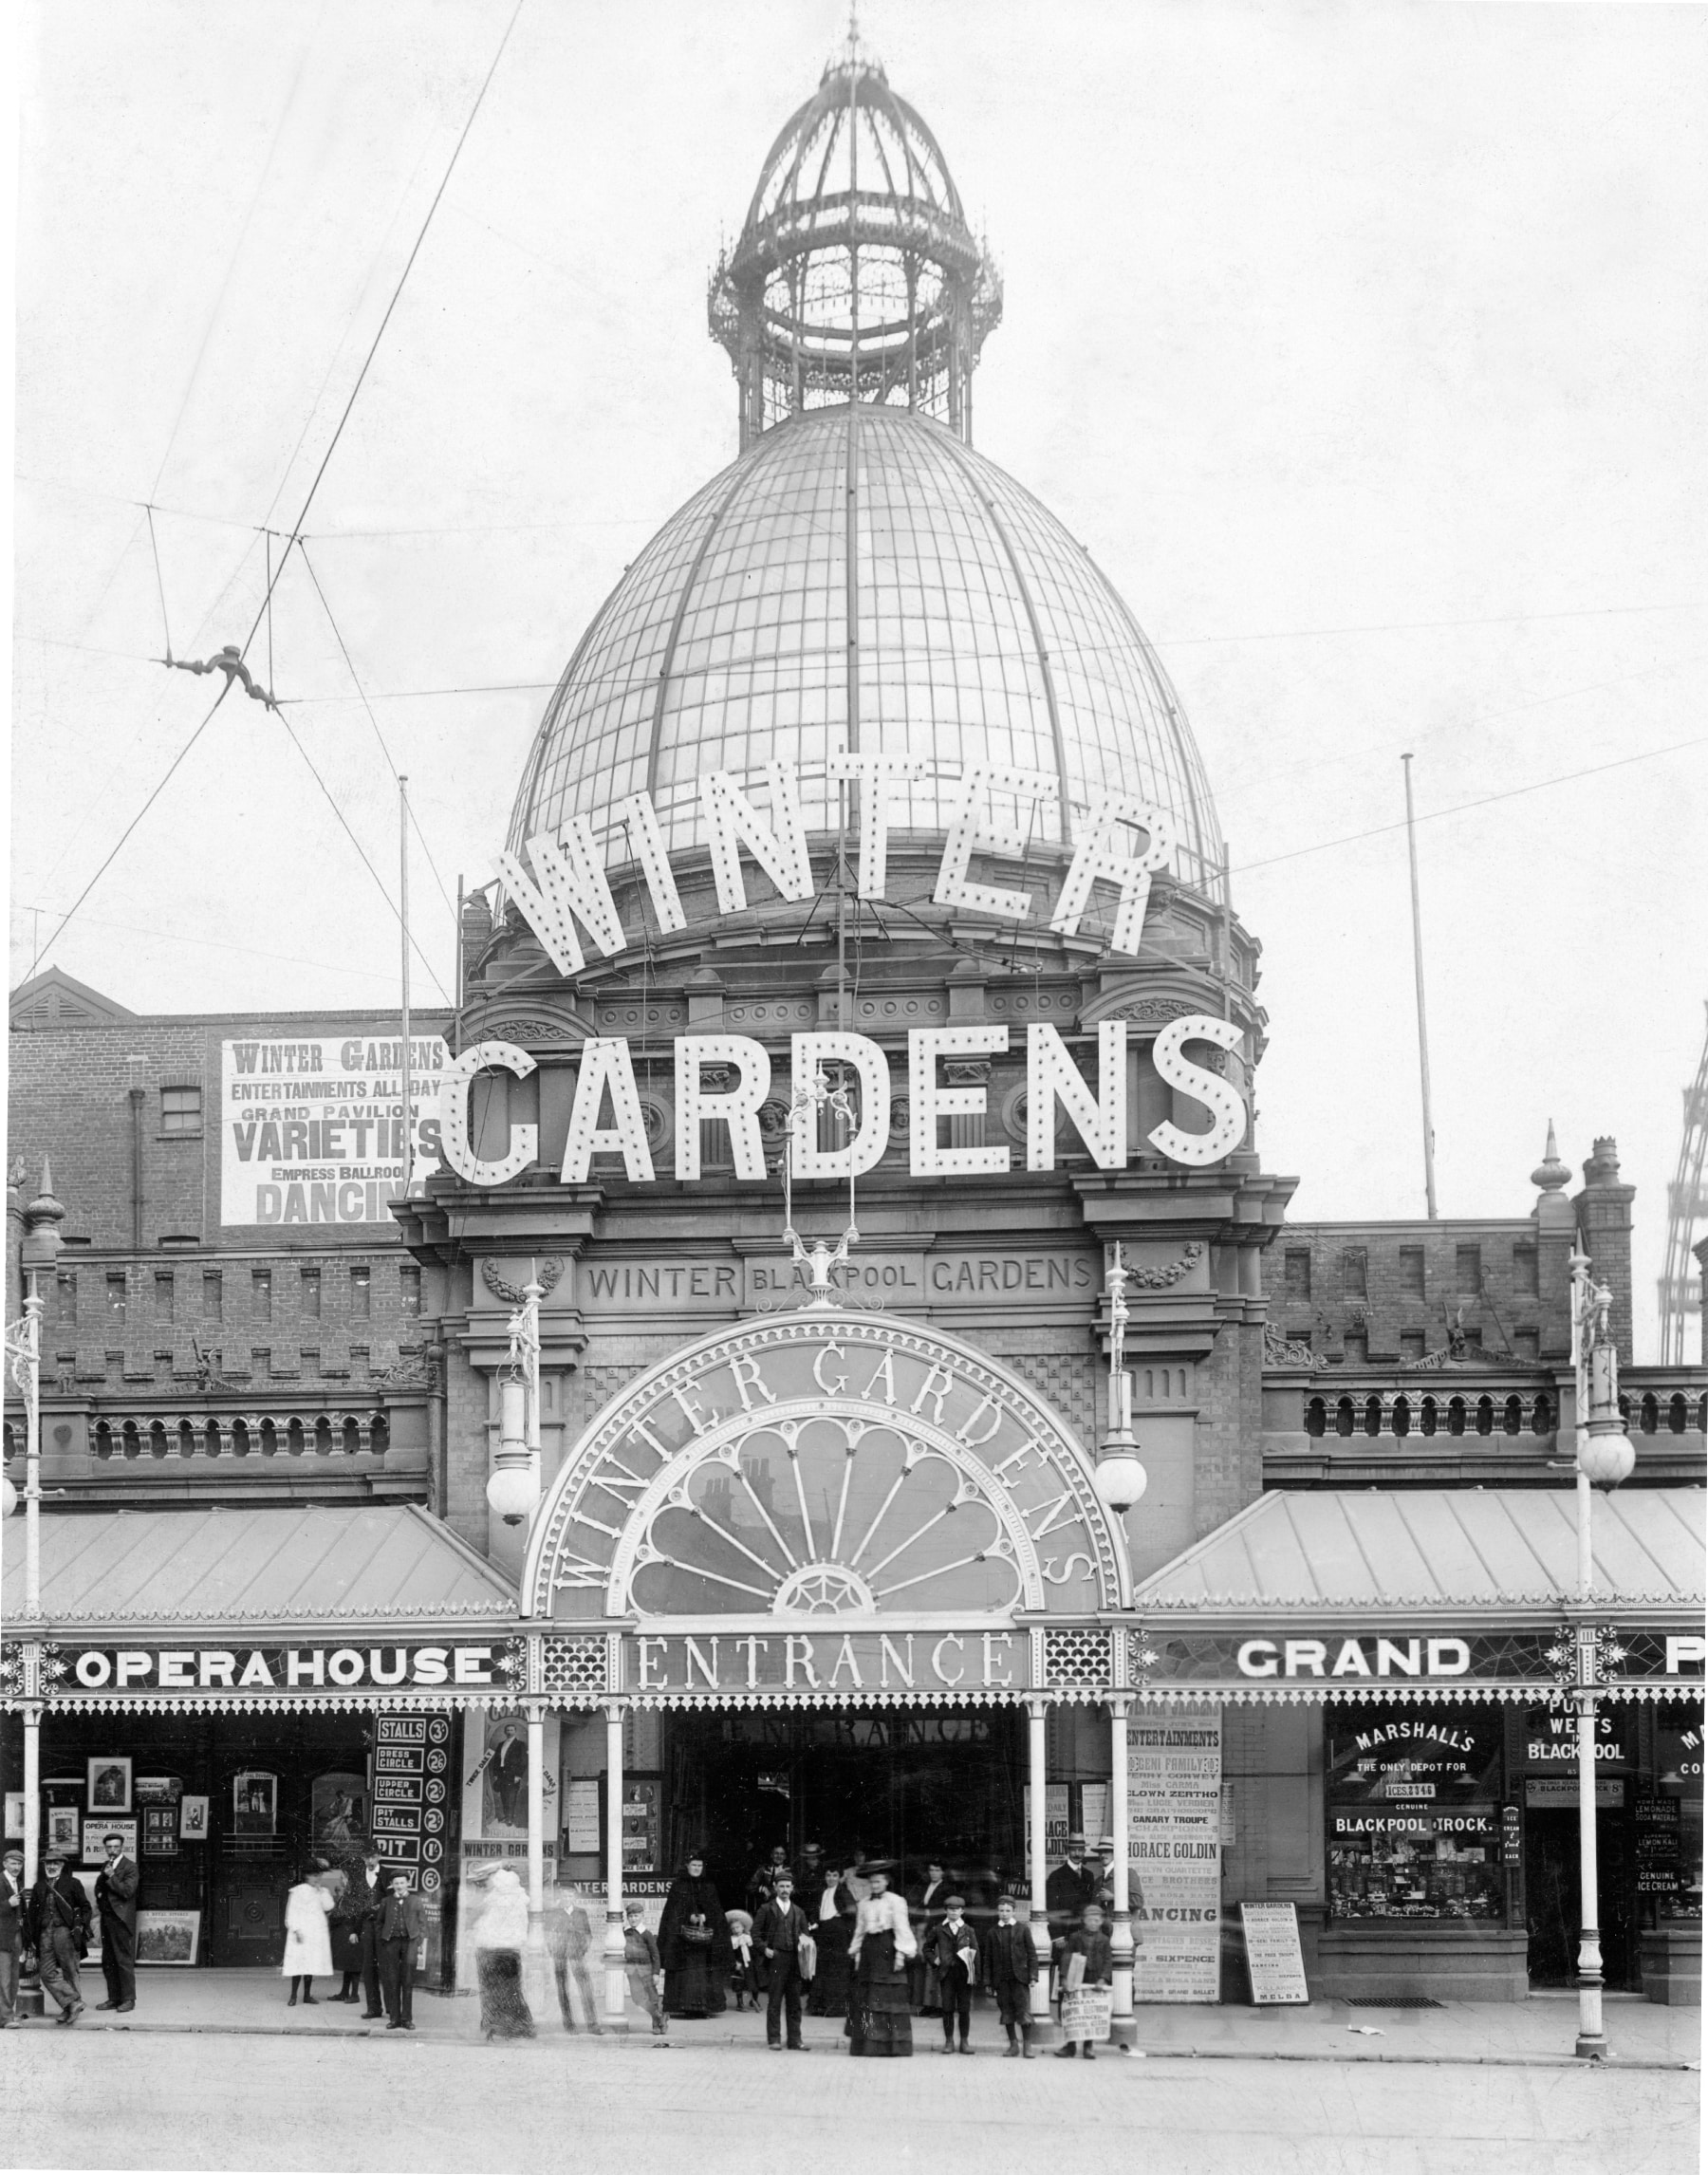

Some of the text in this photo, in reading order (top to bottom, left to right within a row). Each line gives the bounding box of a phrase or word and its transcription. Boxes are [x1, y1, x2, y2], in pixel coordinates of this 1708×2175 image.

[489, 753, 1177, 976] WINTER
[232, 1040, 443, 1074] WINTER GARDENS
[232, 1079, 441, 1100] ENTERTAINMENTS ALL DAY
[439, 1015, 1247, 1186] GARDENS
[241, 1105, 419, 1121] GRAND PAVILION
[232, 1119, 441, 1162] VARIETIES
[271, 1167, 336, 1180] EMPRESS
[752, 1265, 917, 1292] BLAKPOOL
[932, 1257, 1093, 1292] GARDENS
[588, 1267, 736, 1298] WINTER
[553, 1340, 1099, 1589] WINTER GARDENS
[639, 1632, 1014, 1690] ENTRANCE
[1236, 1638, 1472, 1678] GRAND
[1666, 1635, 1706, 1675] P
[76, 1646, 492, 1688] OPERA HOUSE
[381, 1721, 423, 1738] STALLS
[1355, 1722, 1476, 1752] MARSHALL'S
[1126, 1729, 1218, 1747] ENTERTAINMENTS
[380, 1750, 410, 1758] DRESS
[1528, 1743, 1625, 1759] BLACKOOL
[380, 1757, 414, 1768] CIRCLE
[1139, 1757, 1161, 1771] GENI
[1165, 1757, 1203, 1772] FAMILY
[1358, 1763, 1466, 1772] THE ONLY DEPOT FOR
[1680, 1763, 1705, 1775] CO
[379, 1779, 410, 1788] UPPER
[1165, 1781, 1199, 1790] CARMA
[379, 1788, 414, 1797] CIRCLE
[1170, 1790, 1217, 1798] ZERTHO
[377, 1817, 415, 1828] STALLS
[1133, 1815, 1209, 1825] CANARY TROUPE
[1336, 1818, 1427, 1831] BLACKPOOL
[377, 1839, 406, 1856] PIT
[464, 1843, 554, 1858] WINTER GARNS
[1127, 1842, 1216, 1859] HORACE GOLDIN
[1162, 1876, 1217, 1885] BROTHERS
[1640, 1871, 1675, 1880] GENUINE
[573, 1882, 673, 1893] NTER ARDENS
[1008, 1883, 1030, 1895] WIN
[1638, 1881, 1679, 1890] ICE CREAM
[1140, 1907, 1217, 1922] ANCING
